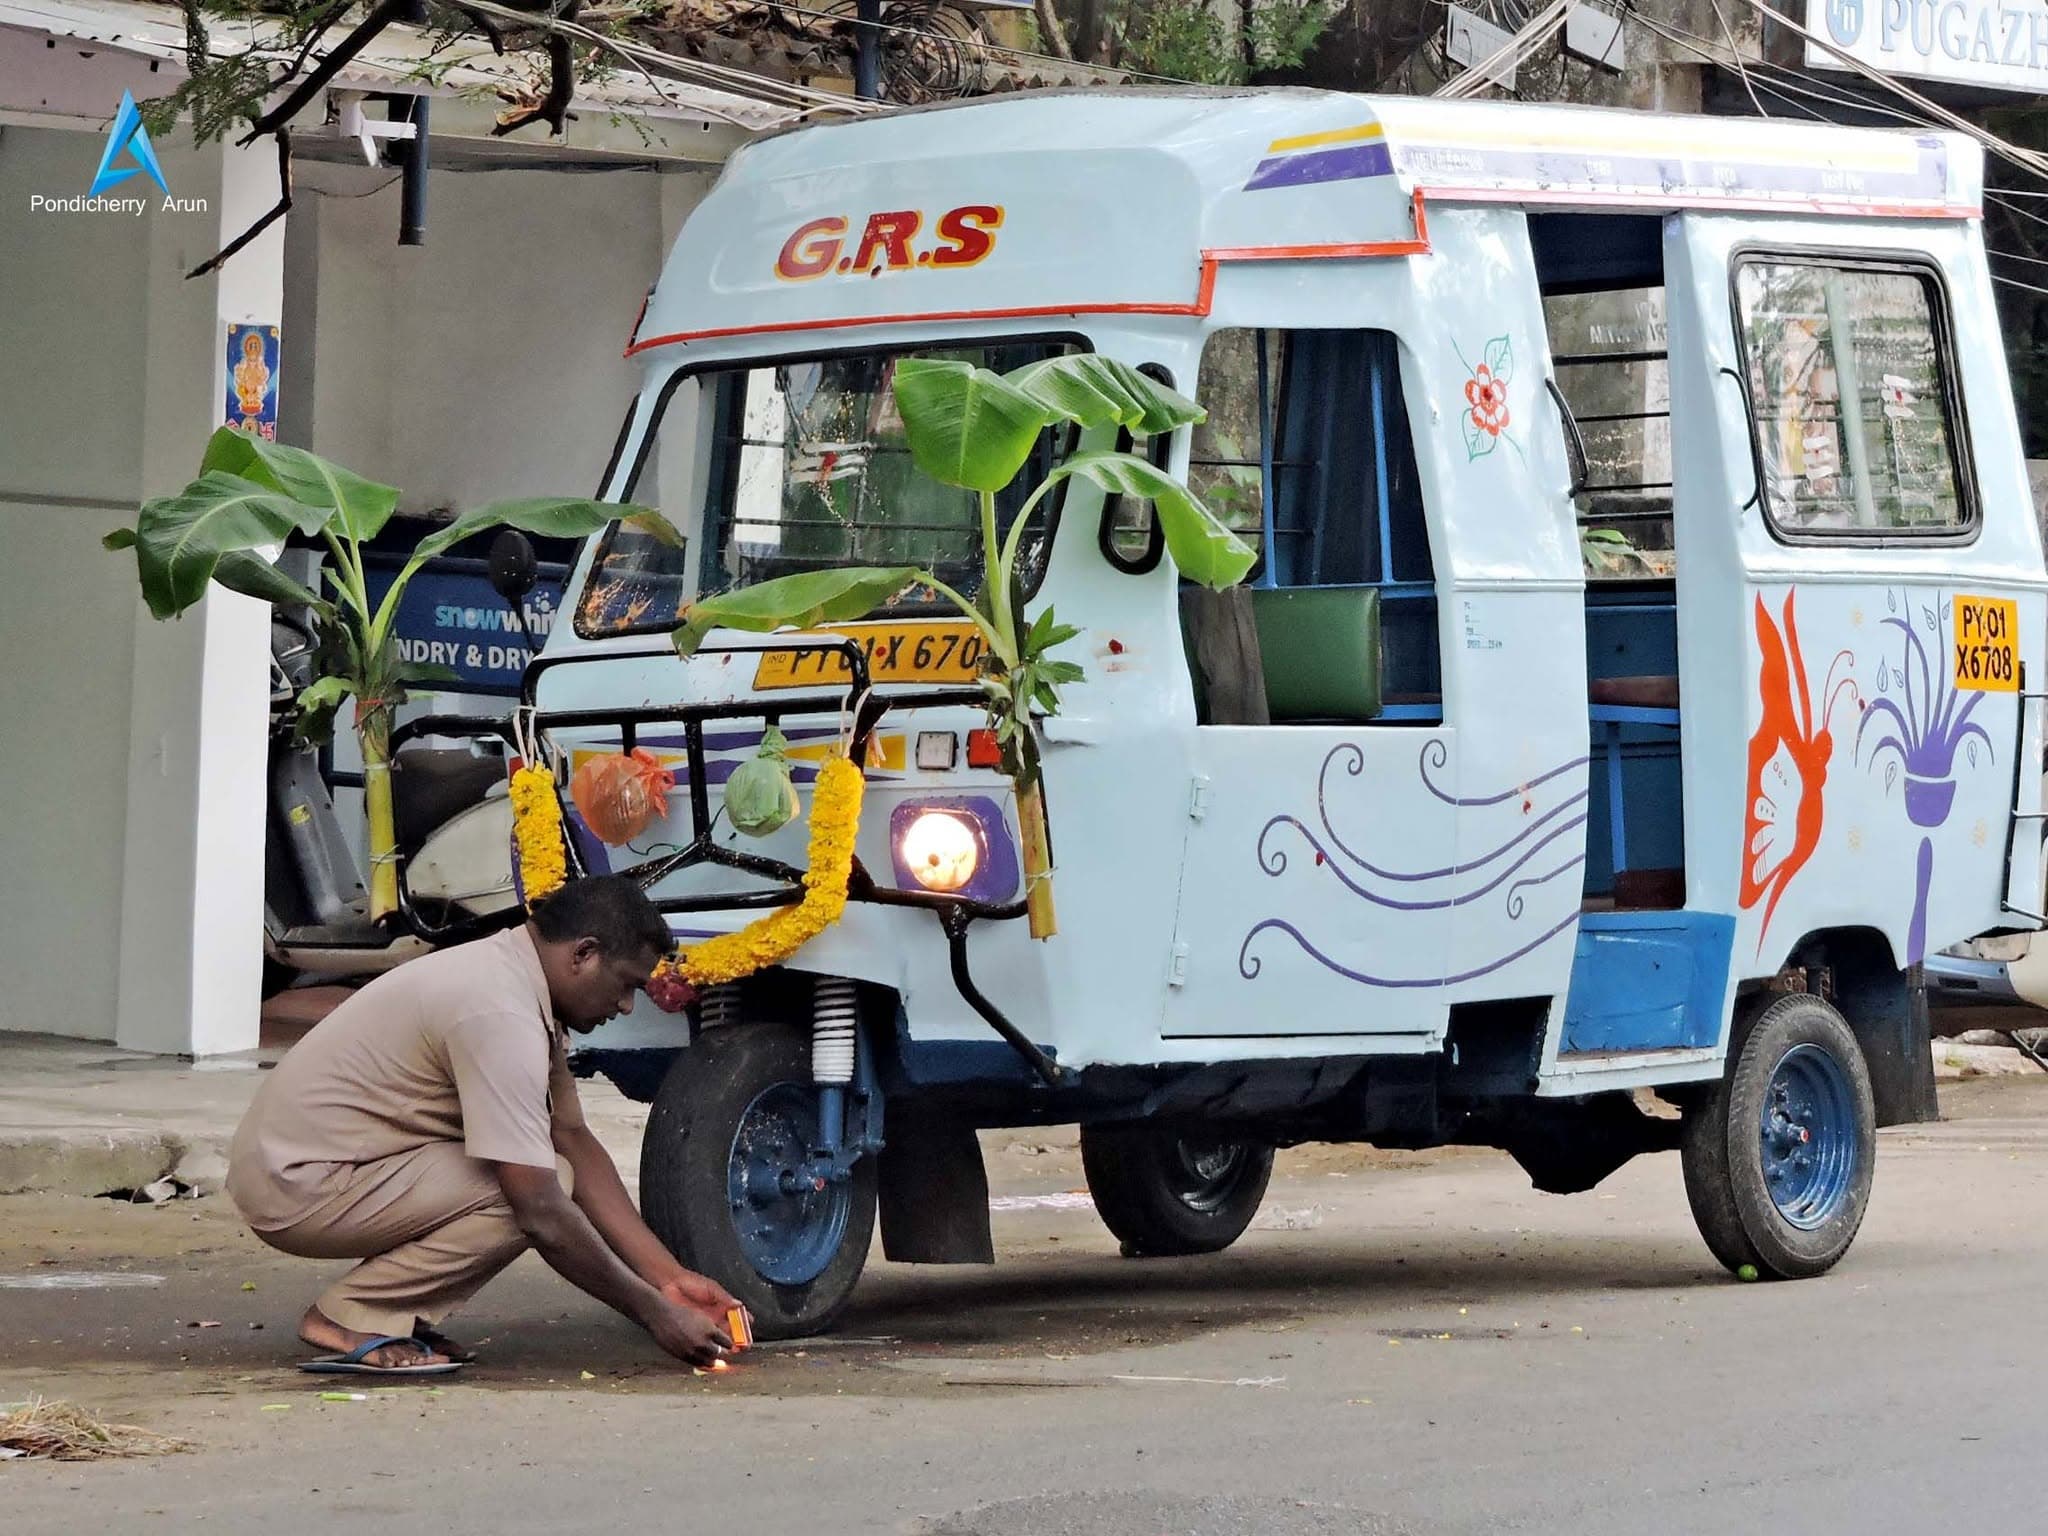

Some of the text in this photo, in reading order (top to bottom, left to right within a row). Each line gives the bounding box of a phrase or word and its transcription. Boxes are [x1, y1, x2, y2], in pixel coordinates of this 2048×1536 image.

[465, 644, 483, 668] &
[488, 646, 536, 671] DRY
[913, 634, 990, 671] 670
